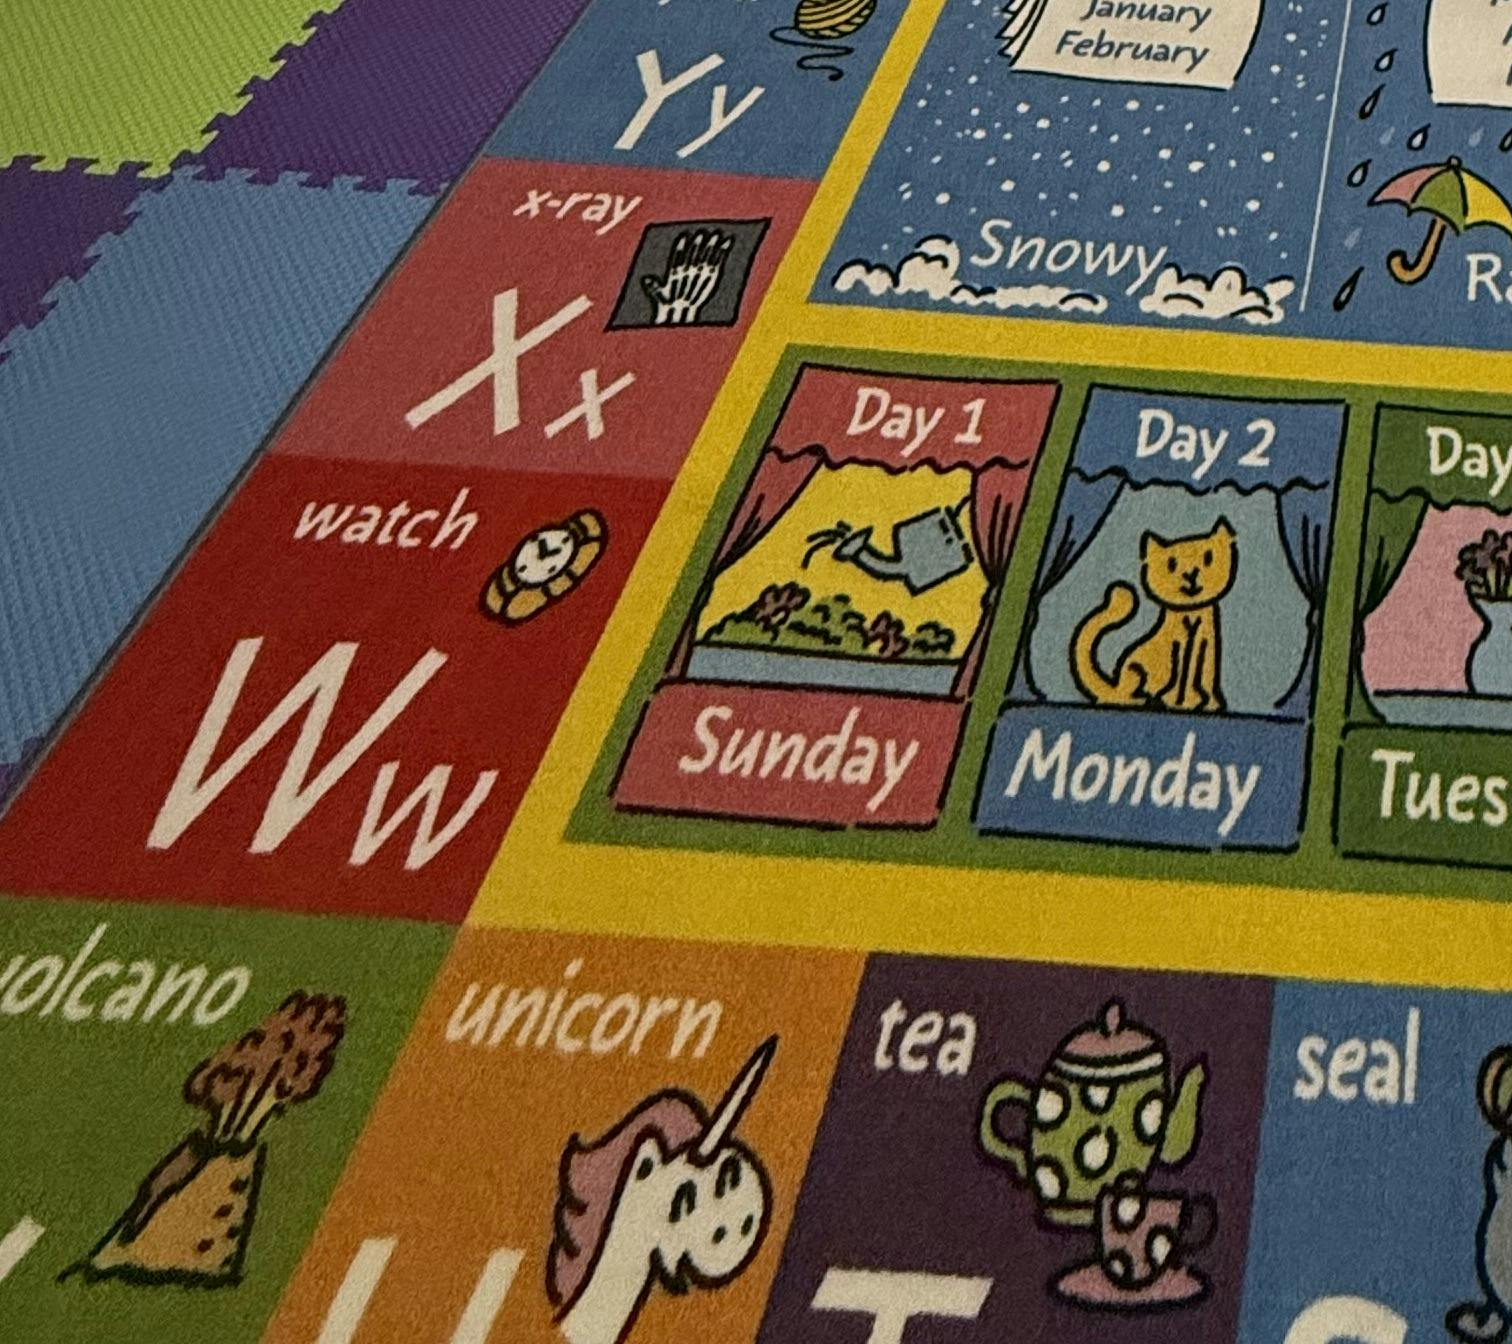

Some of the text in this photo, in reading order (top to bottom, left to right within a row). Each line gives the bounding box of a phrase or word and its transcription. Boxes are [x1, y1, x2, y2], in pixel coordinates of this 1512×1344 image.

[1055, 30, 1210, 73] February
[612, 48, 767, 160] Yy
[513, 184, 642, 235] x-ray
[970, 219, 1168, 297] Snowy
[404, 288, 639, 441] Xx
[845, 387, 987, 457] Day 1
[1134, 408, 1277, 480] Day 2
[293, 487, 481, 552] watch
[144, 636, 498, 872] Ww
[678, 705, 921, 812] Sunday
[1003, 730, 1261, 837] Monday
[444, 958, 726, 1062] unicorn
[872, 997, 979, 1078] tea
[1293, 1007, 1422, 1106] seal
